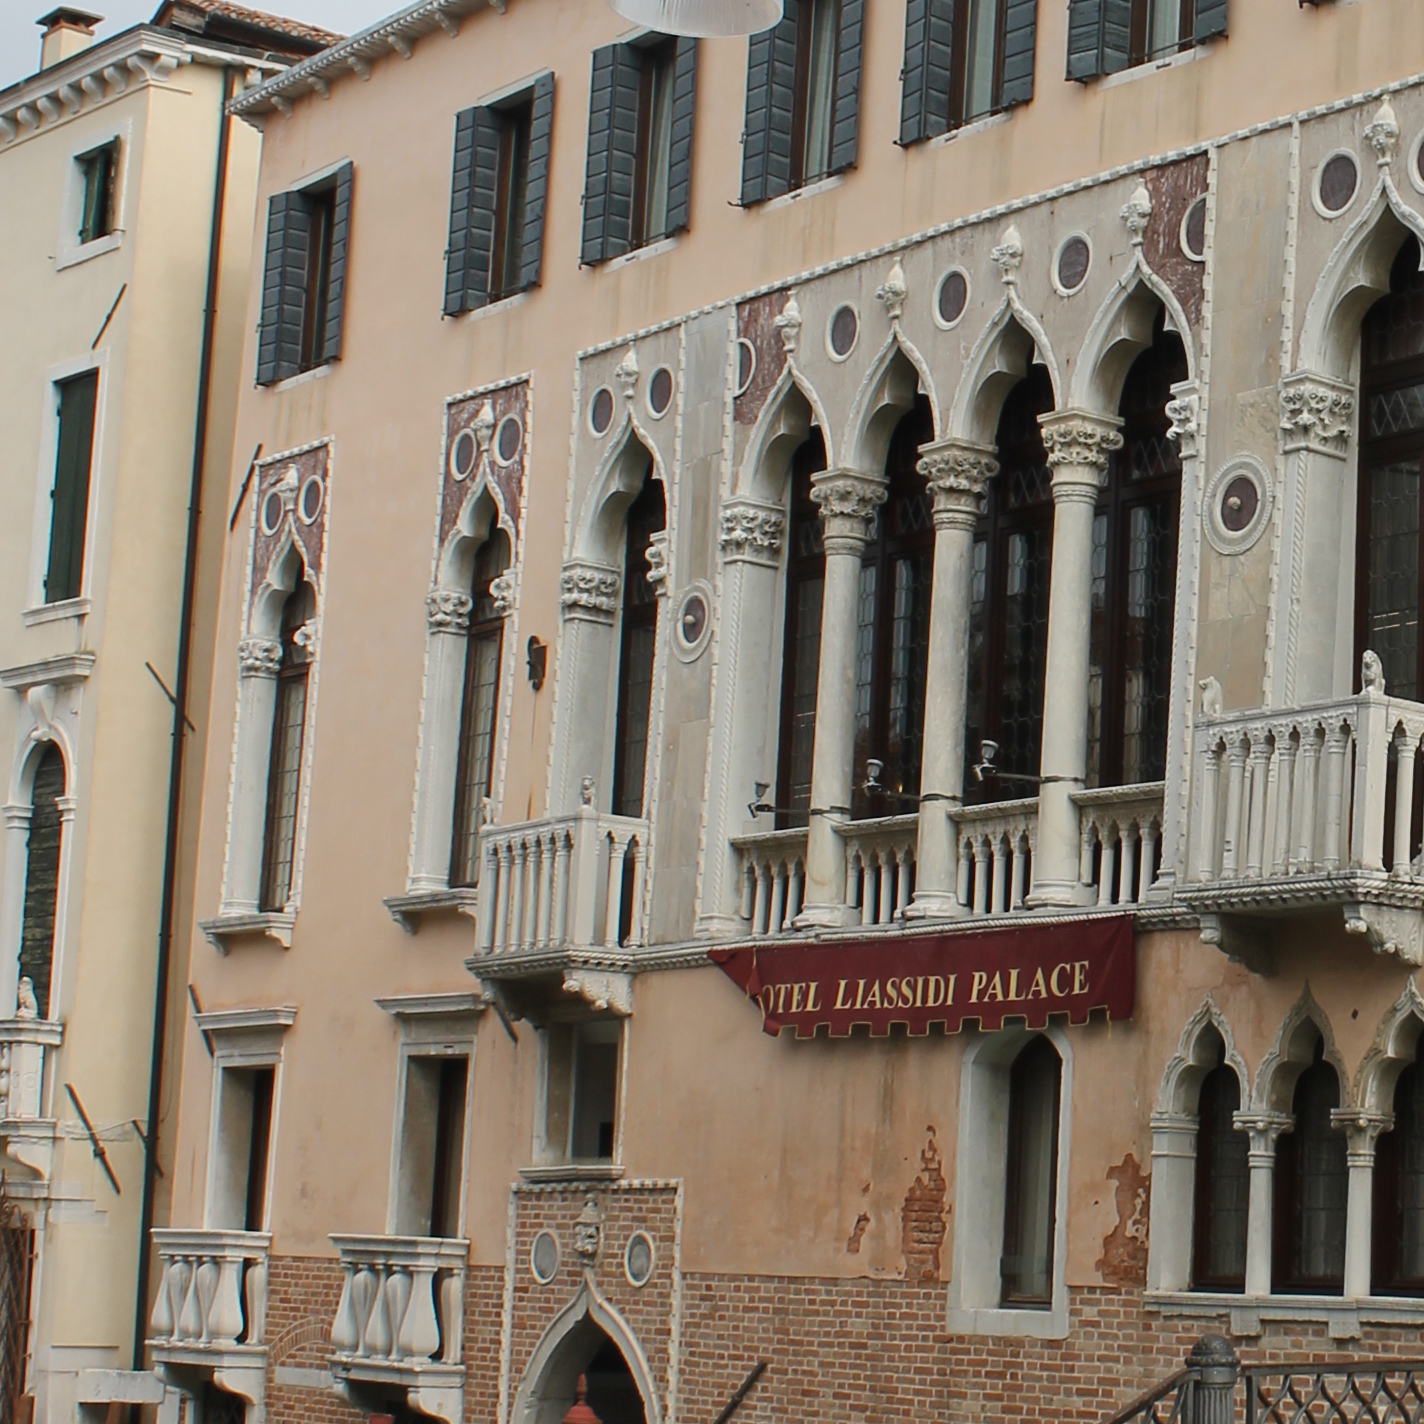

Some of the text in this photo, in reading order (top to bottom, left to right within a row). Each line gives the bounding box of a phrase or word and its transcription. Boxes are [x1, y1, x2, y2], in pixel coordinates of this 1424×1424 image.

[761, 960, 1090, 1014] OTEL LIASSIDI PALACE
